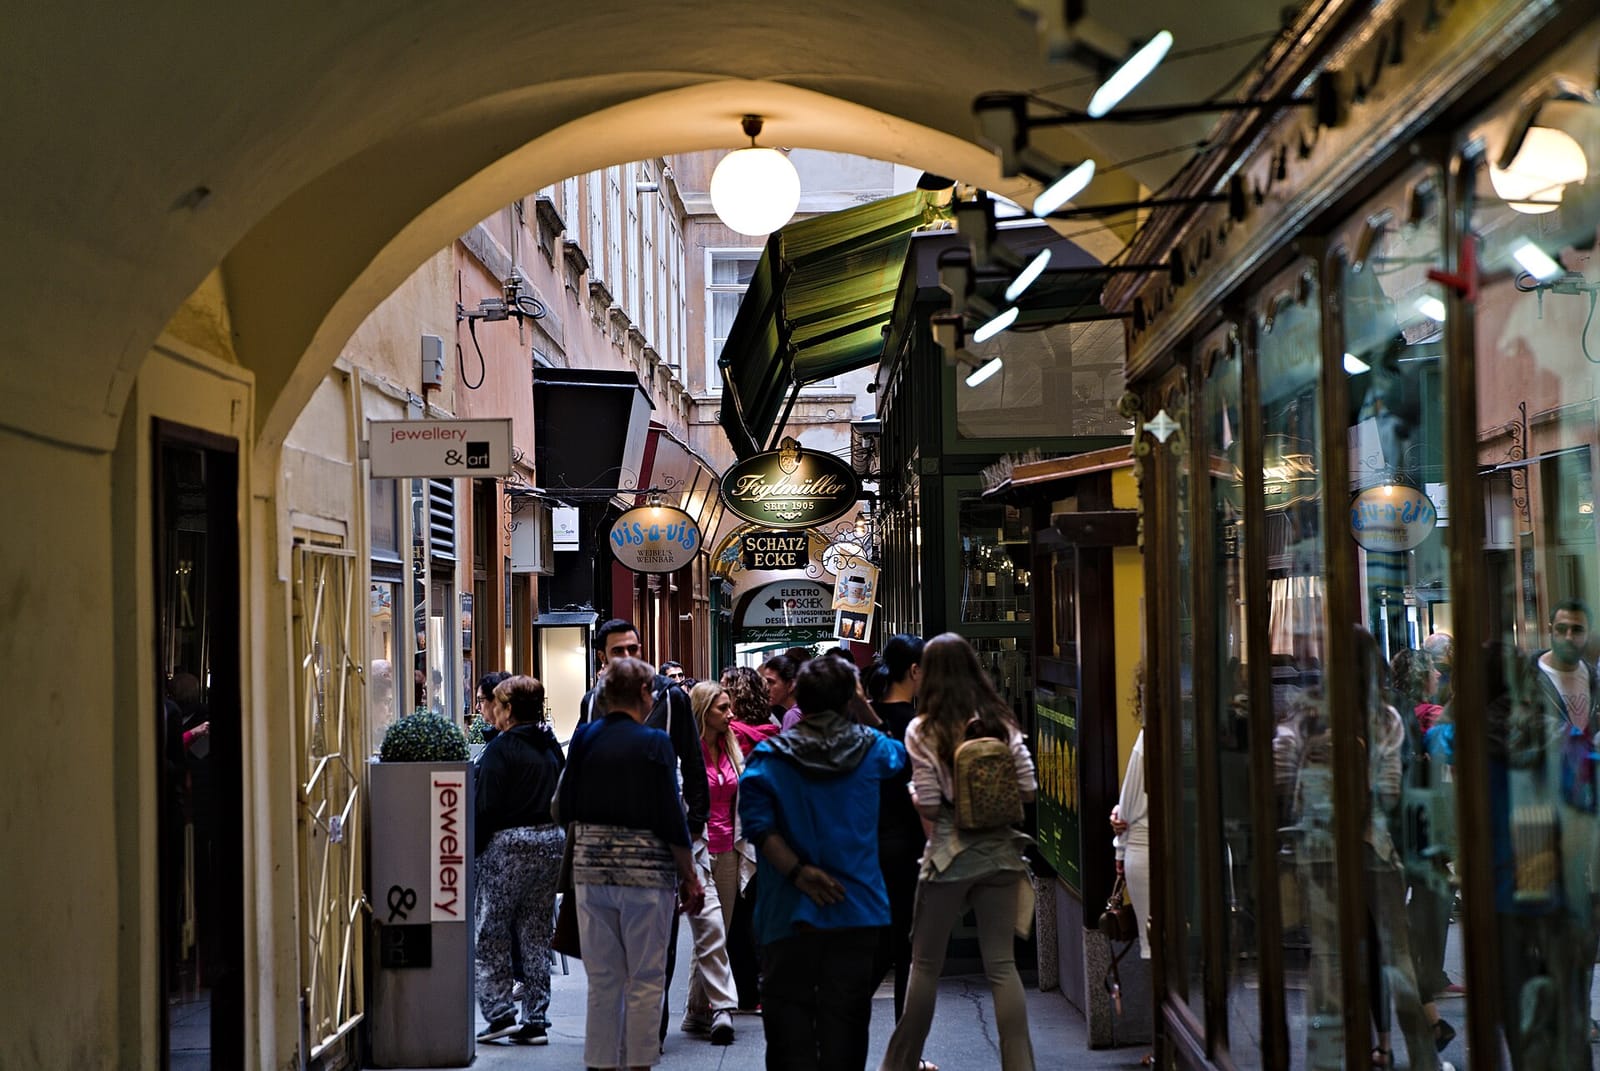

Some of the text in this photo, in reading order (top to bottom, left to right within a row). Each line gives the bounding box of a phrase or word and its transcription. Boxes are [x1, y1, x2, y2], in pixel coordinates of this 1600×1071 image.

[390, 427, 467, 444] jewellery
[444, 449, 488, 466] & art
[731, 474, 846, 503] Figlmüller
[764, 501, 815, 511] SEIT 1905
[611, 520, 698, 550] vis-a-vis
[636, 556, 675, 564] WEINBAR
[637, 549, 673, 557] WEIBEL'S
[754, 552, 797, 567] ECKE
[780, 588, 820, 597] ELEKTRO
[782, 609, 834, 617] RUNGSDIENST
[797, 616, 818, 624] LICHT
[434, 780, 463, 917] jewellery
[387, 885, 417, 923] &
